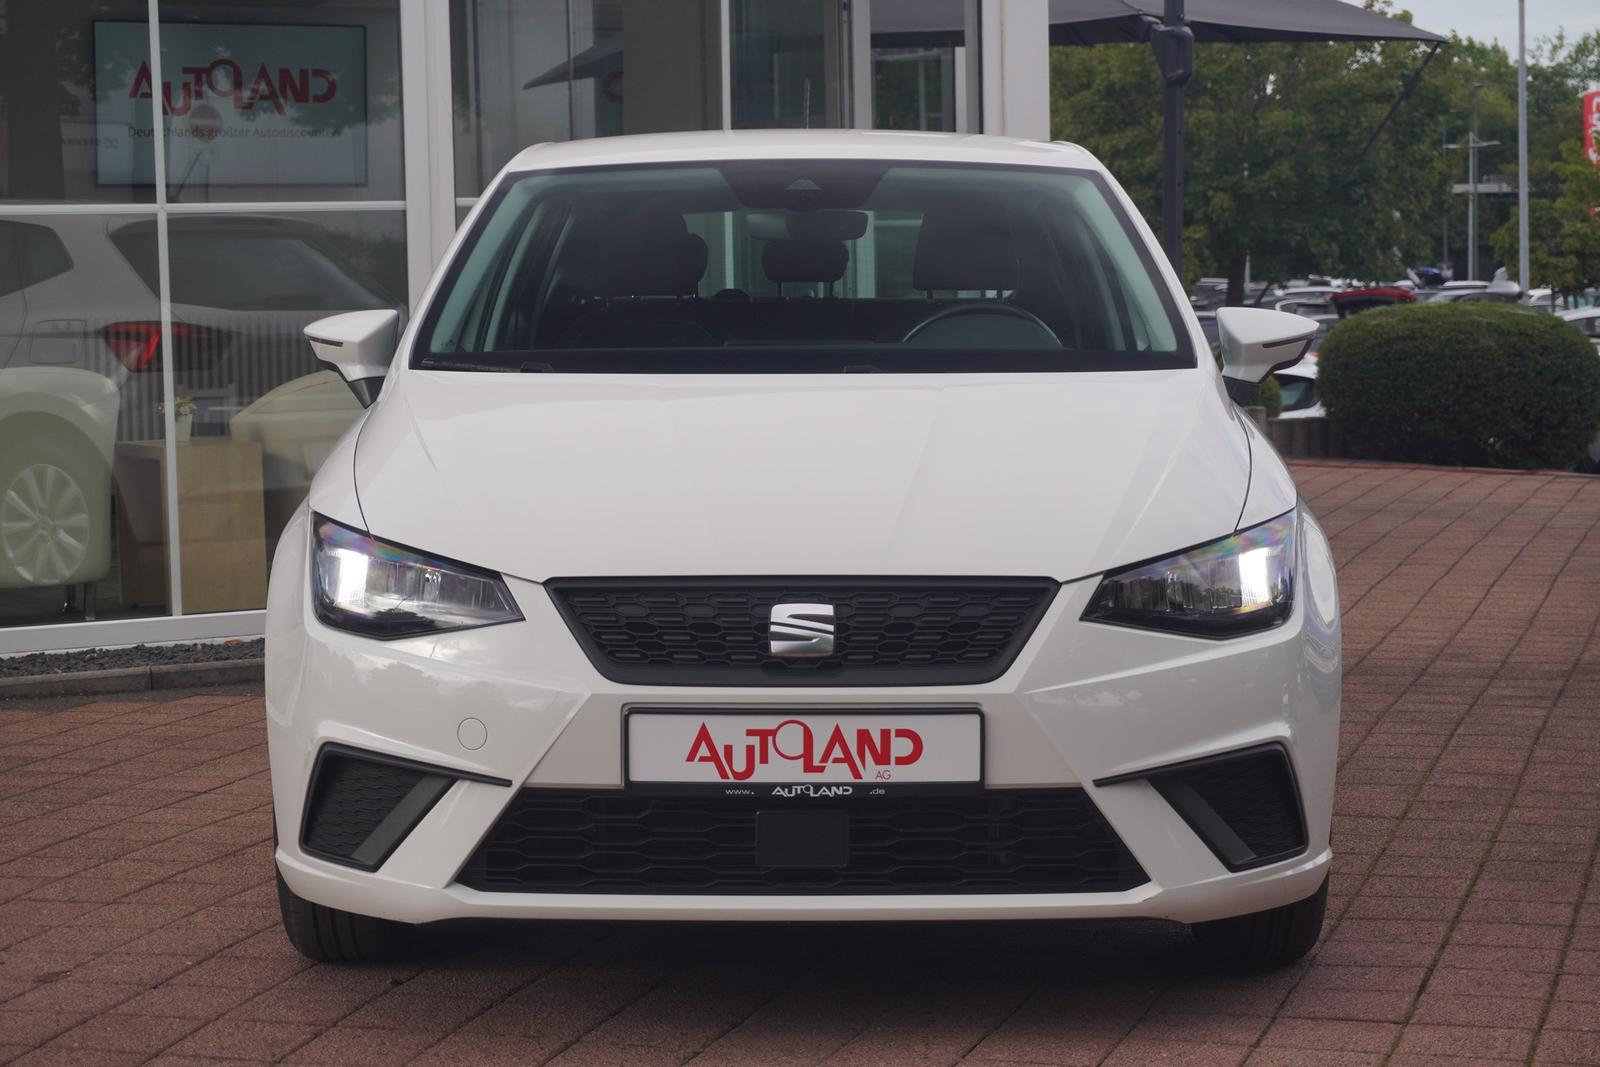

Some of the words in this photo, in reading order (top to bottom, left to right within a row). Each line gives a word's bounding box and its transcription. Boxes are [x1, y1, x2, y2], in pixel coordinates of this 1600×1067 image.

[129, 58, 337, 116] AUTOLAND
[128, 126, 206, 138] Deutchlands
[685, 719, 924, 781] AUTOLAND
[875, 770, 892, 781] AG
[771, 783, 853, 798] AUTOLAND
[869, 787, 886, 796] .de
